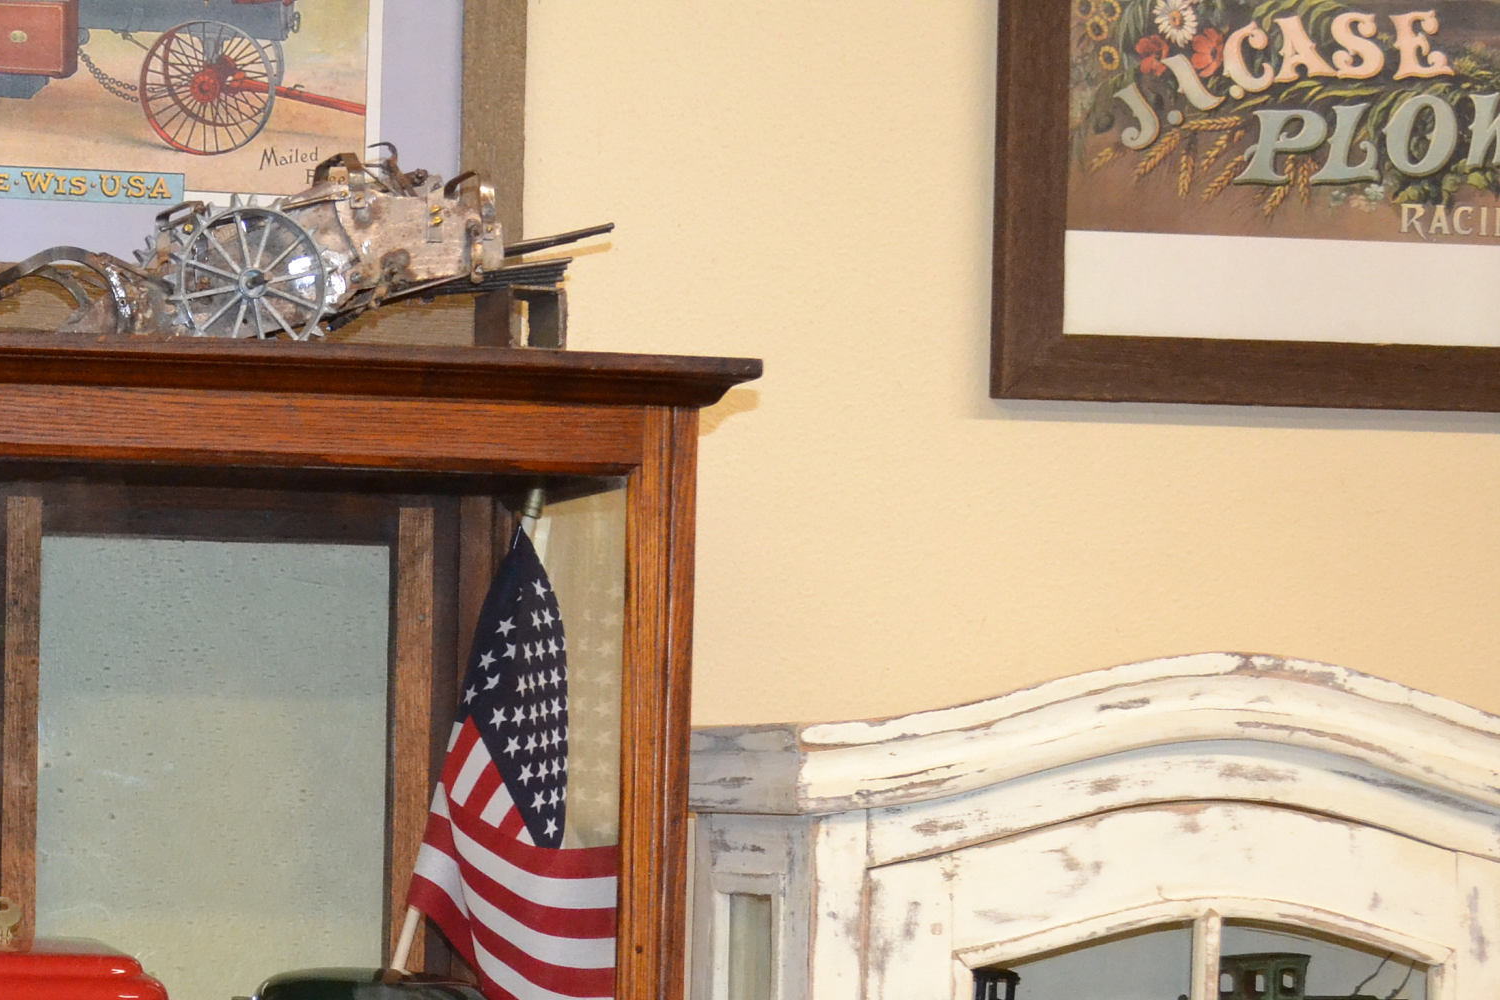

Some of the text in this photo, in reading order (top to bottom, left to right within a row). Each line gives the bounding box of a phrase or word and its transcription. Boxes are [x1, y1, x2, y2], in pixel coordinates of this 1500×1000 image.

[259, 147, 319, 171] Mailed
[306, 168, 346, 185] Fee
[1400, 203, 1500, 241] RACI
